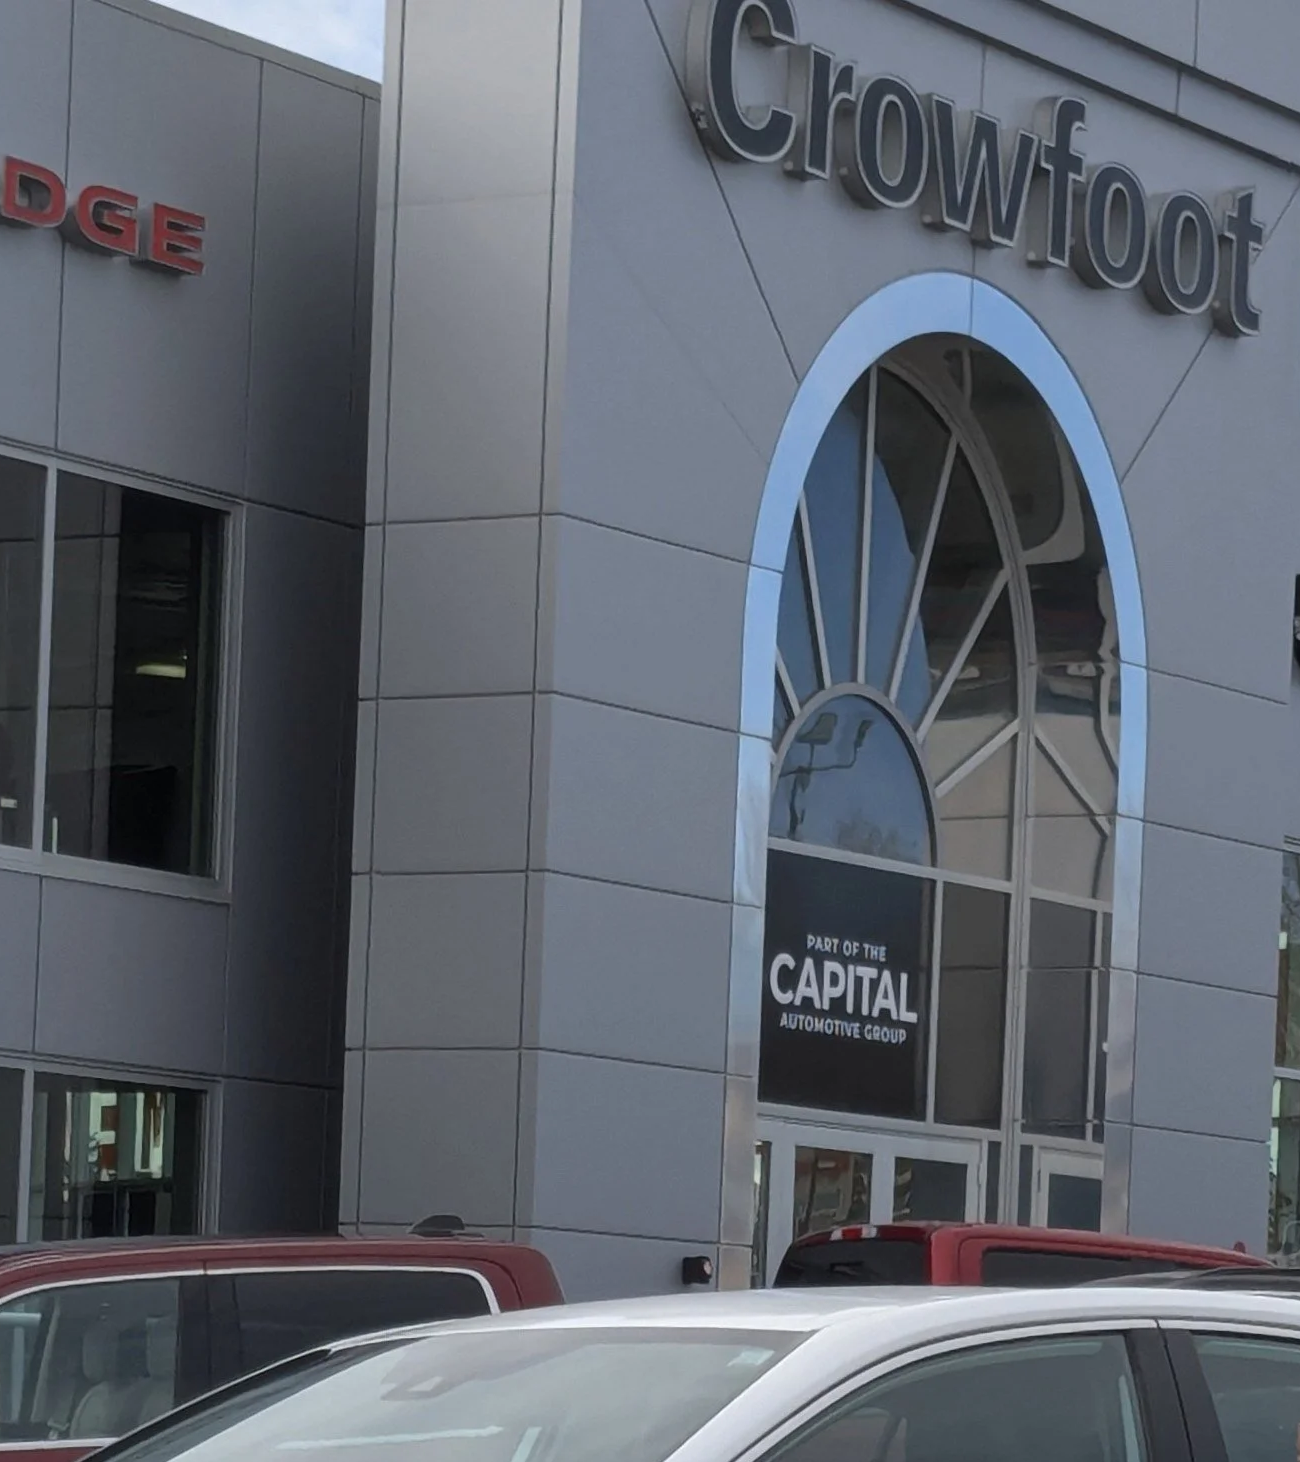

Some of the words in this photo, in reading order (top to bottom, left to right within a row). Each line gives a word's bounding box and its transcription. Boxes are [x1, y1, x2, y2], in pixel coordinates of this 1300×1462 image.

[699, 0, 1265, 337] Crowfoot
[806, 934, 840, 954] PART
[842, 940, 860, 957] OF
[862, 943, 888, 962] THE
[769, 952, 919, 1024] CAPITAL
[779, 1011, 861, 1039] AUTOMOTIVE
[864, 1023, 908, 1045] GROUP
